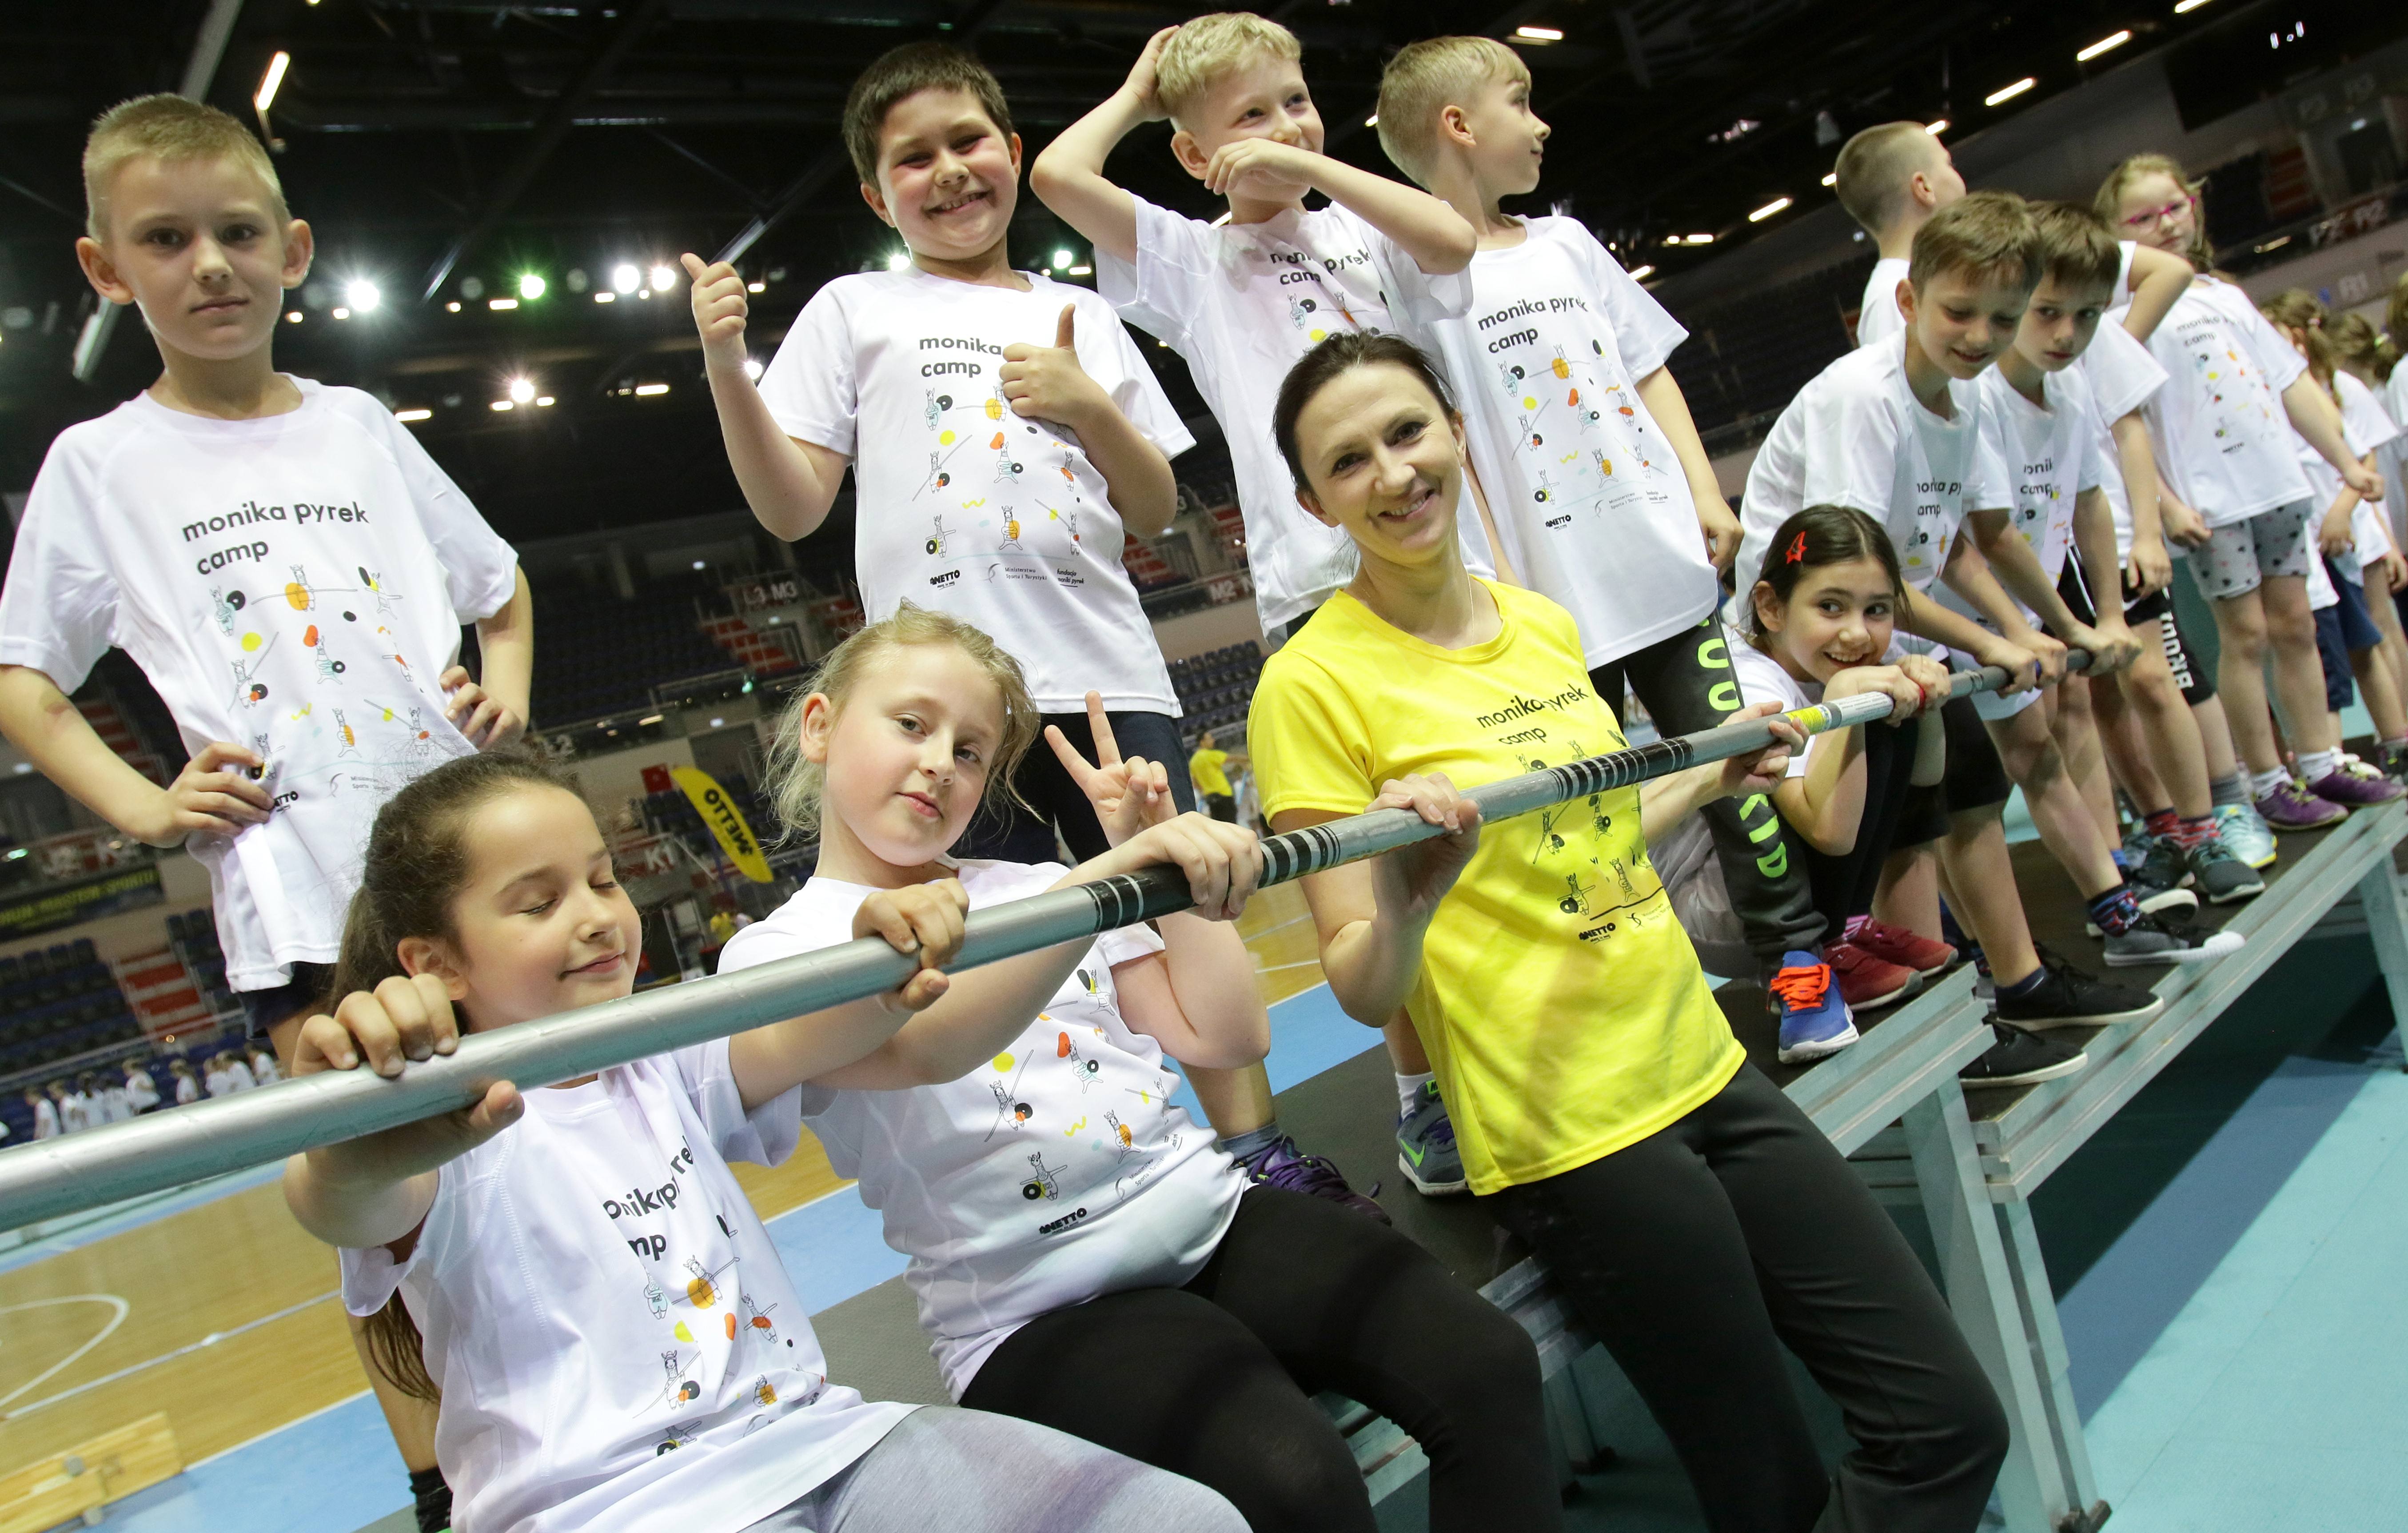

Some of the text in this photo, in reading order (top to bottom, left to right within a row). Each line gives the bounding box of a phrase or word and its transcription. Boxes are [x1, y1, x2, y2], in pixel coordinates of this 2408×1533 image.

[1478, 299, 1546, 330] monika
[920, 337, 1001, 355] monika
[1488, 328, 1538, 353] camp
[921, 362, 981, 378] camp
[183, 501, 370, 542] monika pyrek
[1549, 515, 1571, 527] NETTO
[1918, 504, 1941, 519] amp
[196, 541, 269, 575] camp
[933, 569, 961, 585] NETTO
[1476, 695, 1545, 728] monika
[1498, 728, 1547, 743] camp
[274, 790, 299, 807] TTO
[1584, 922, 1616, 939] NETTO
[1129, 1158, 1154, 1180] Ministerstwo
[602, 1188, 665, 1220] onik
[1044, 1207, 1087, 1233] NETTO
[627, 1234, 666, 1262] mp
